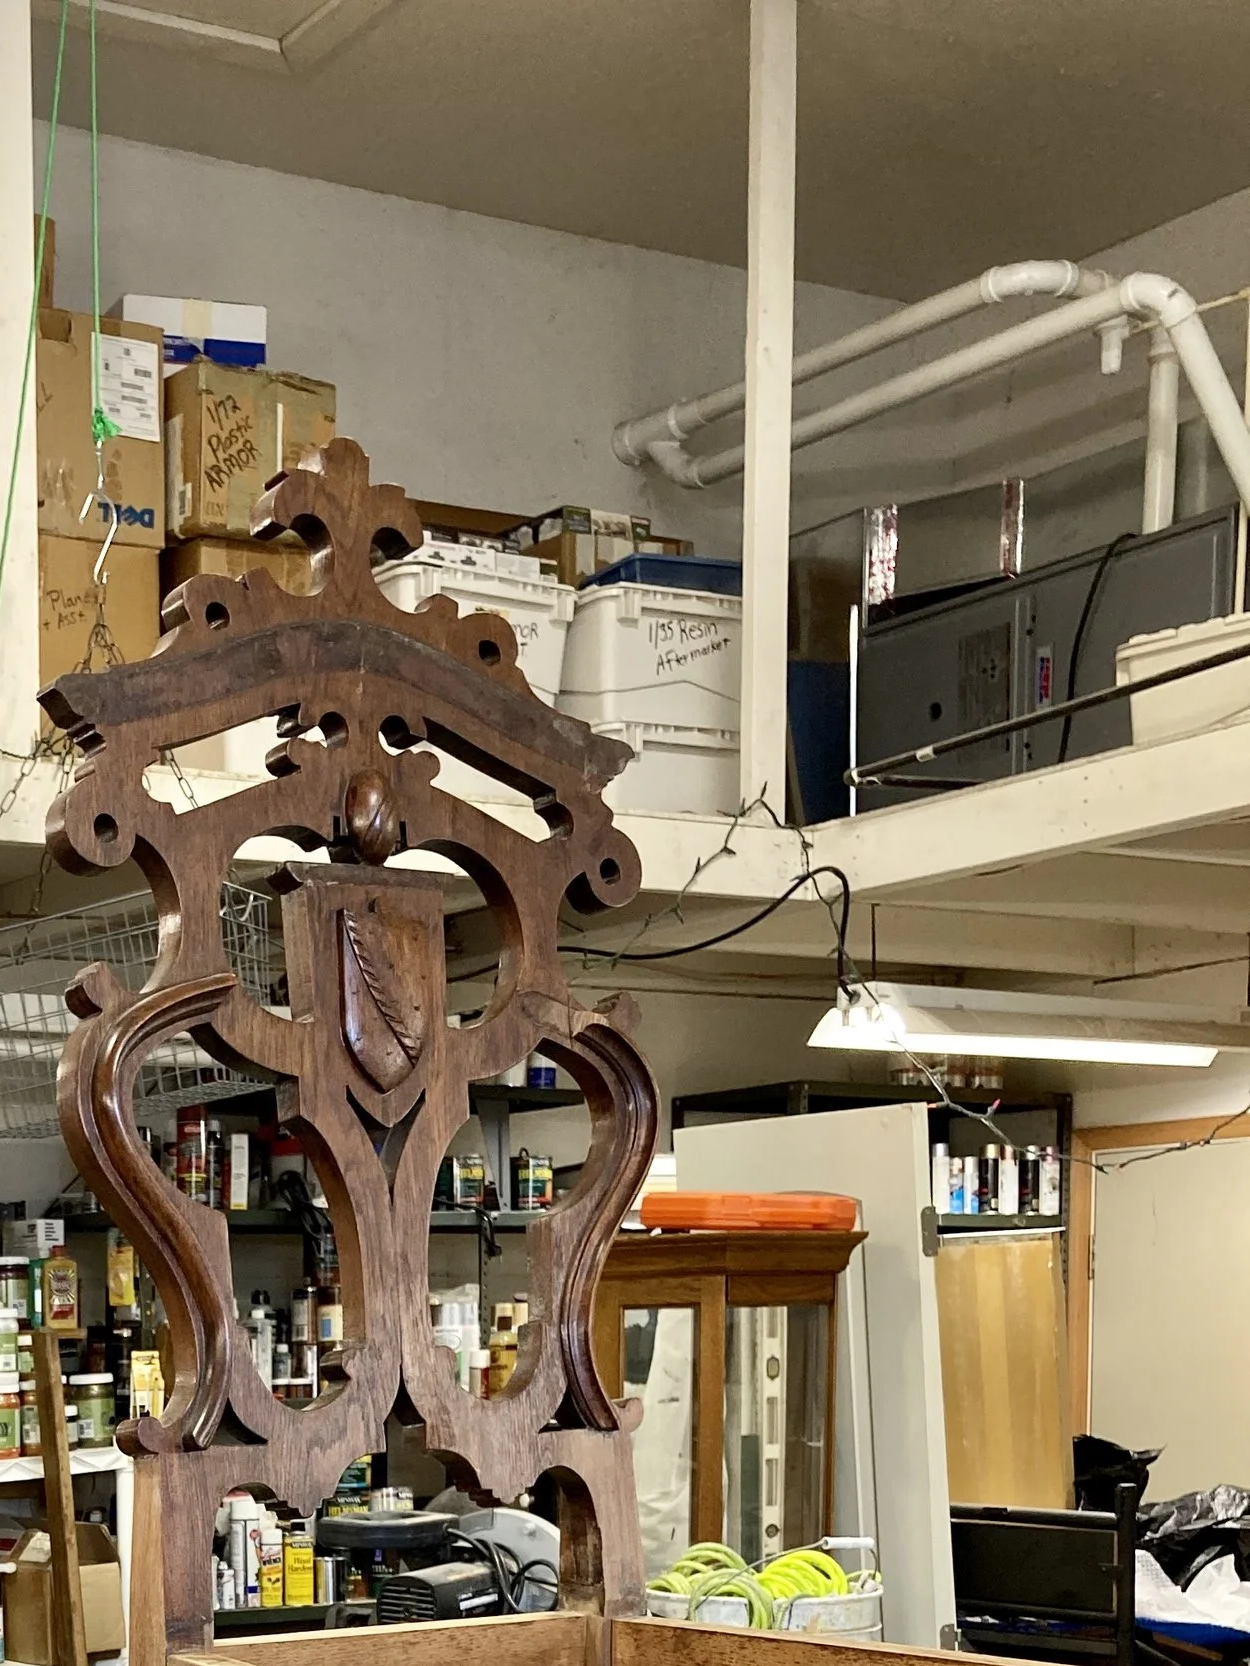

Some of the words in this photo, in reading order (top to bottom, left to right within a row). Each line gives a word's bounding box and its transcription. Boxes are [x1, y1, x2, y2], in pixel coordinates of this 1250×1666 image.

[205, 394, 242, 432] 1/72
[204, 439, 262, 493] ARMOR
[649, 619, 674, 650] 1/35
[678, 617, 718, 645] Resin
